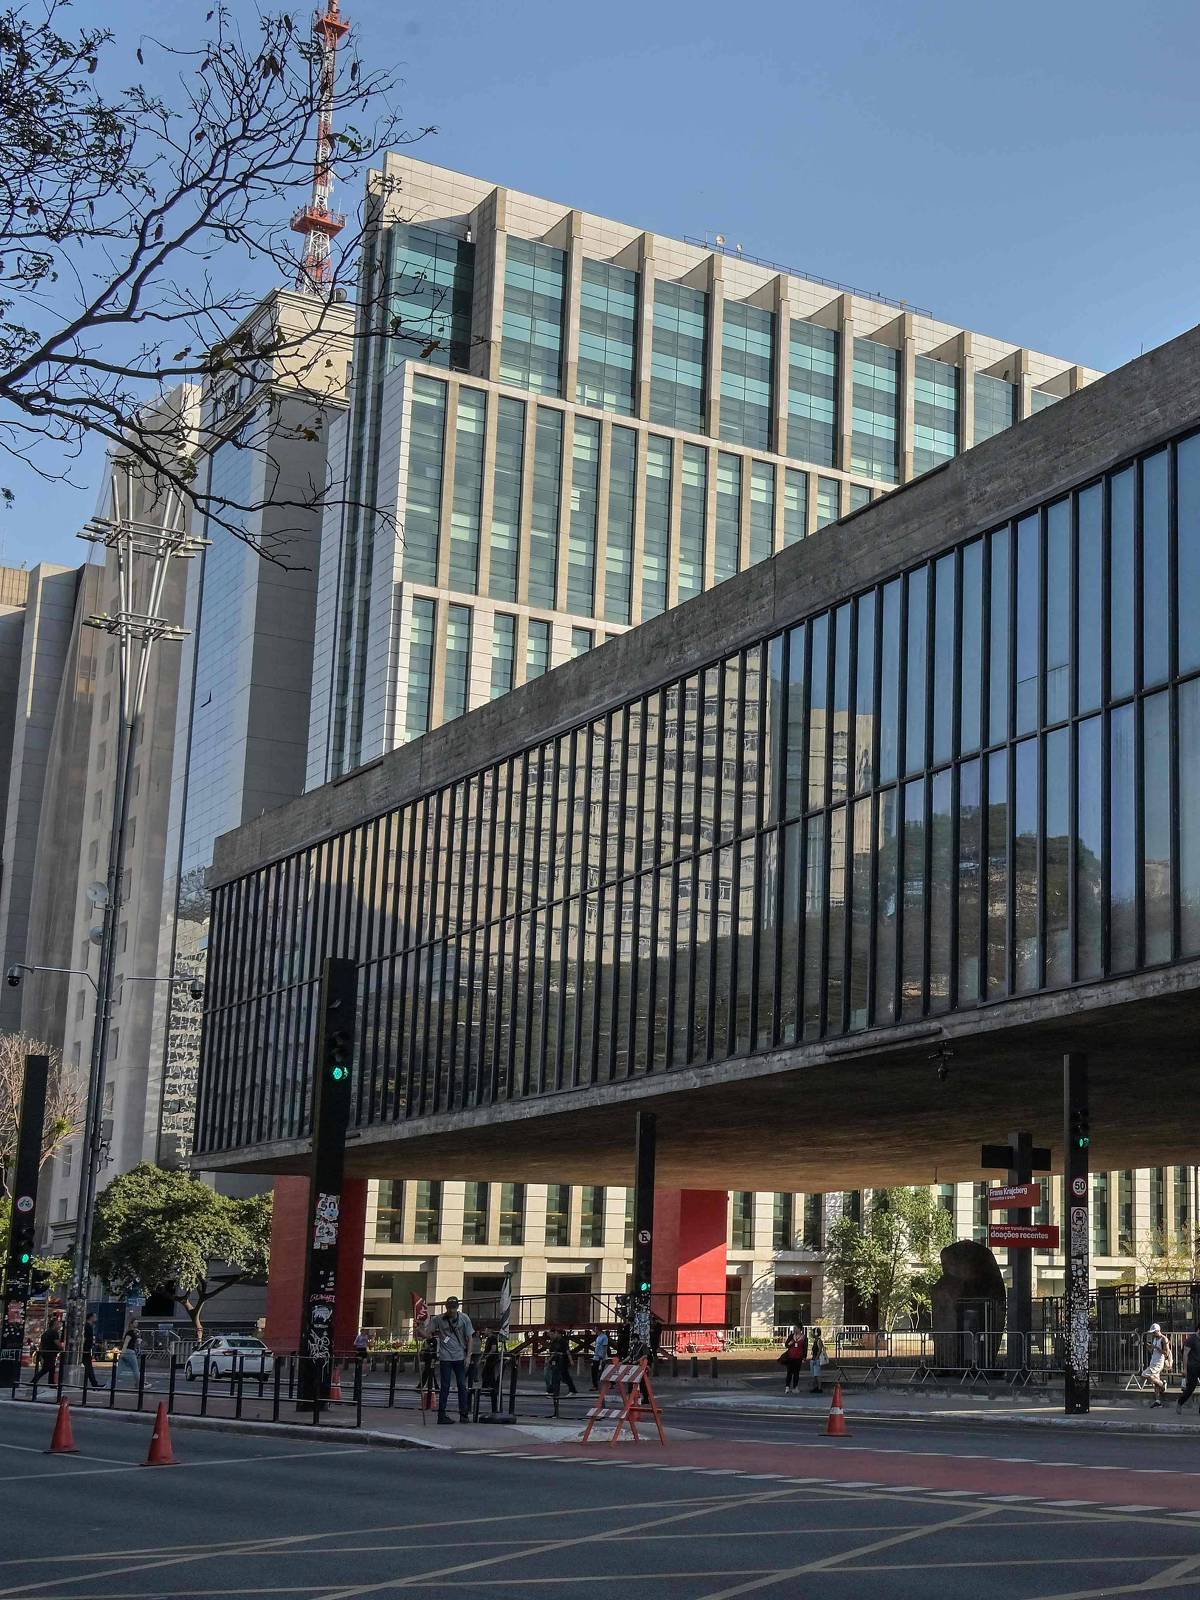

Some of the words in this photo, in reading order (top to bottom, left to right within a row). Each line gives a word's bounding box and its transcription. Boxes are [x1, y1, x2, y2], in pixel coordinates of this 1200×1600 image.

[1075, 1181, 1085, 1190] 50
[990, 1188, 1003, 1197] Frans
[991, 1231, 1019, 1240] doações
[1020, 1232, 1049, 1240] recentes
